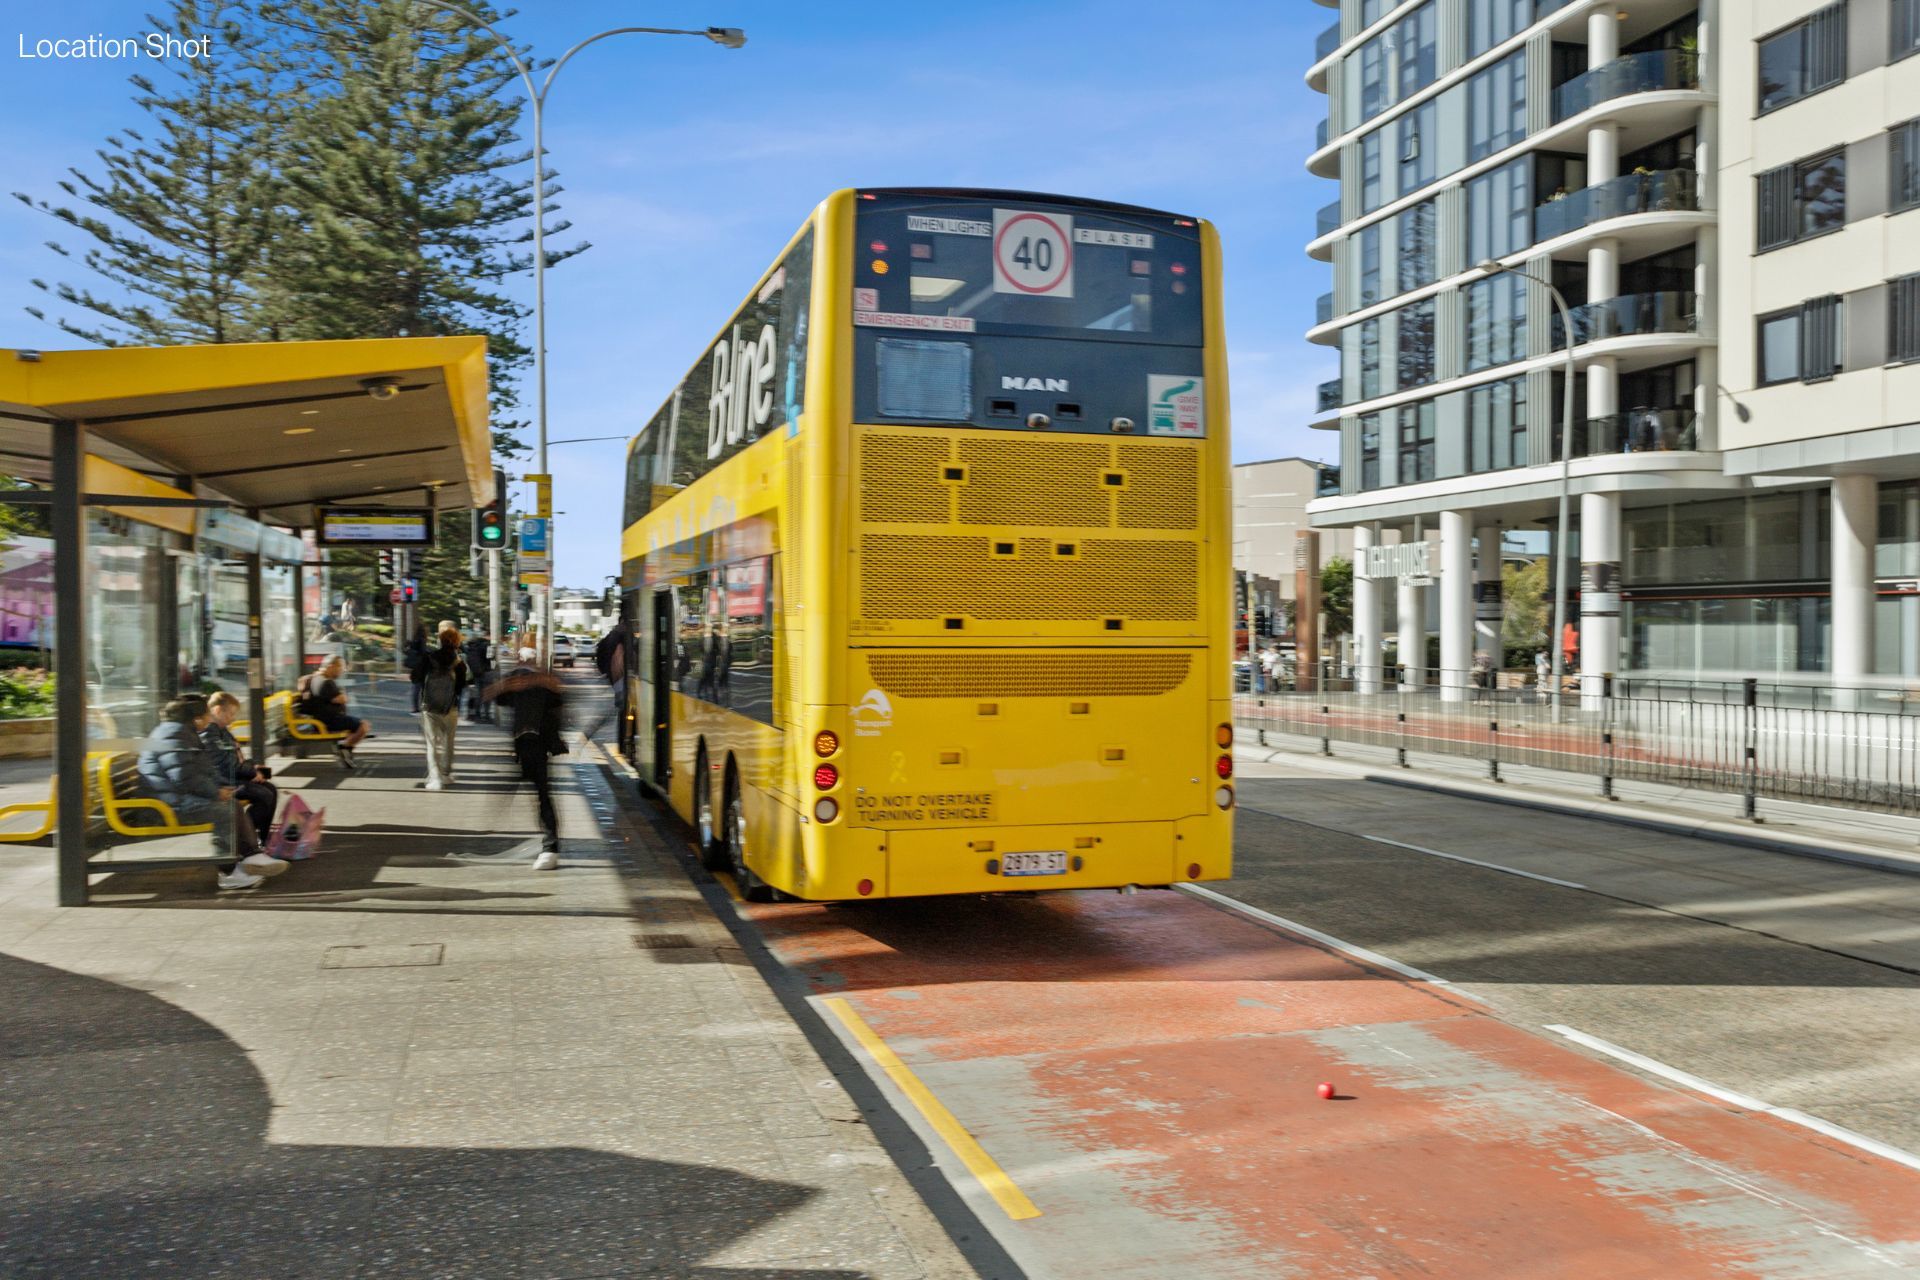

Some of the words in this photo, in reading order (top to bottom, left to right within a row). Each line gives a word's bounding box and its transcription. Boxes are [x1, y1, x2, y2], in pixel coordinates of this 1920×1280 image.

[908, 216, 945, 231] WHEN
[949, 220, 992, 235] LIGHTS
[1080, 230, 1146, 246] FLASH
[1012, 236, 1052, 272] 40
[858, 313, 938, 327] EMERGENCY
[943, 318, 971, 329] EXIT
[1002, 376, 1069, 392] MAN
[855, 796, 877, 808] DO
[882, 795, 913, 807] NOT
[917, 793, 992, 807] OVERTAKE
[859, 808, 925, 822] TURNING
[929, 806, 990, 820] VEHICLE
